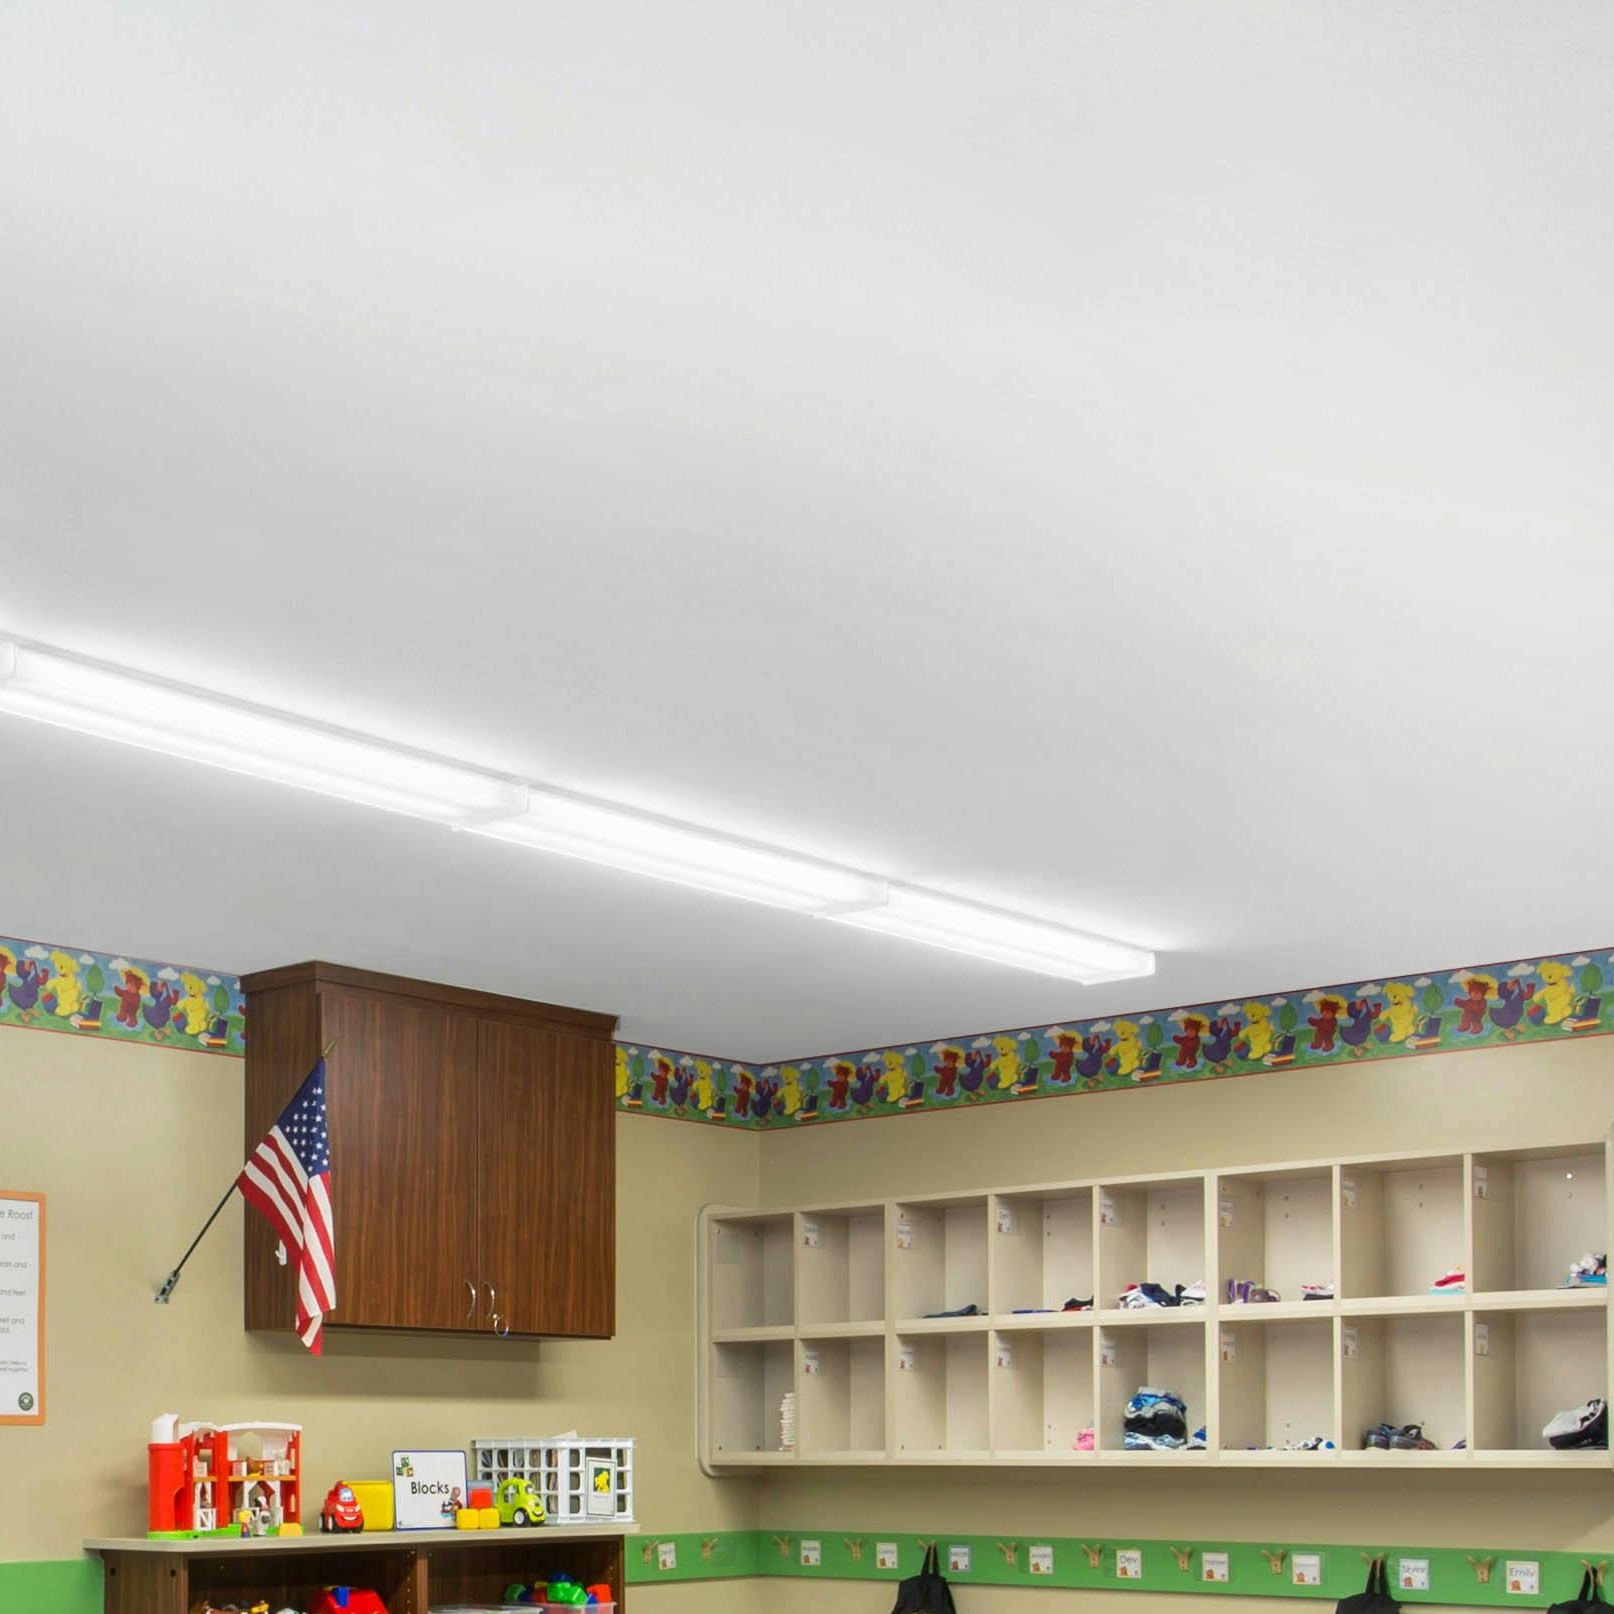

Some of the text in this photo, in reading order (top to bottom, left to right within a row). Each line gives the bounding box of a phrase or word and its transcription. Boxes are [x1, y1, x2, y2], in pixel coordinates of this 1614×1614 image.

[7, 1209, 33, 1221] Roost
[1, 1233, 15, 1241] and
[11, 1317, 25, 1325] and
[410, 1480, 450, 1495] Blocks
[1120, 1554, 1139, 1564] Dev
[1509, 1567, 1534, 1578] Emily
